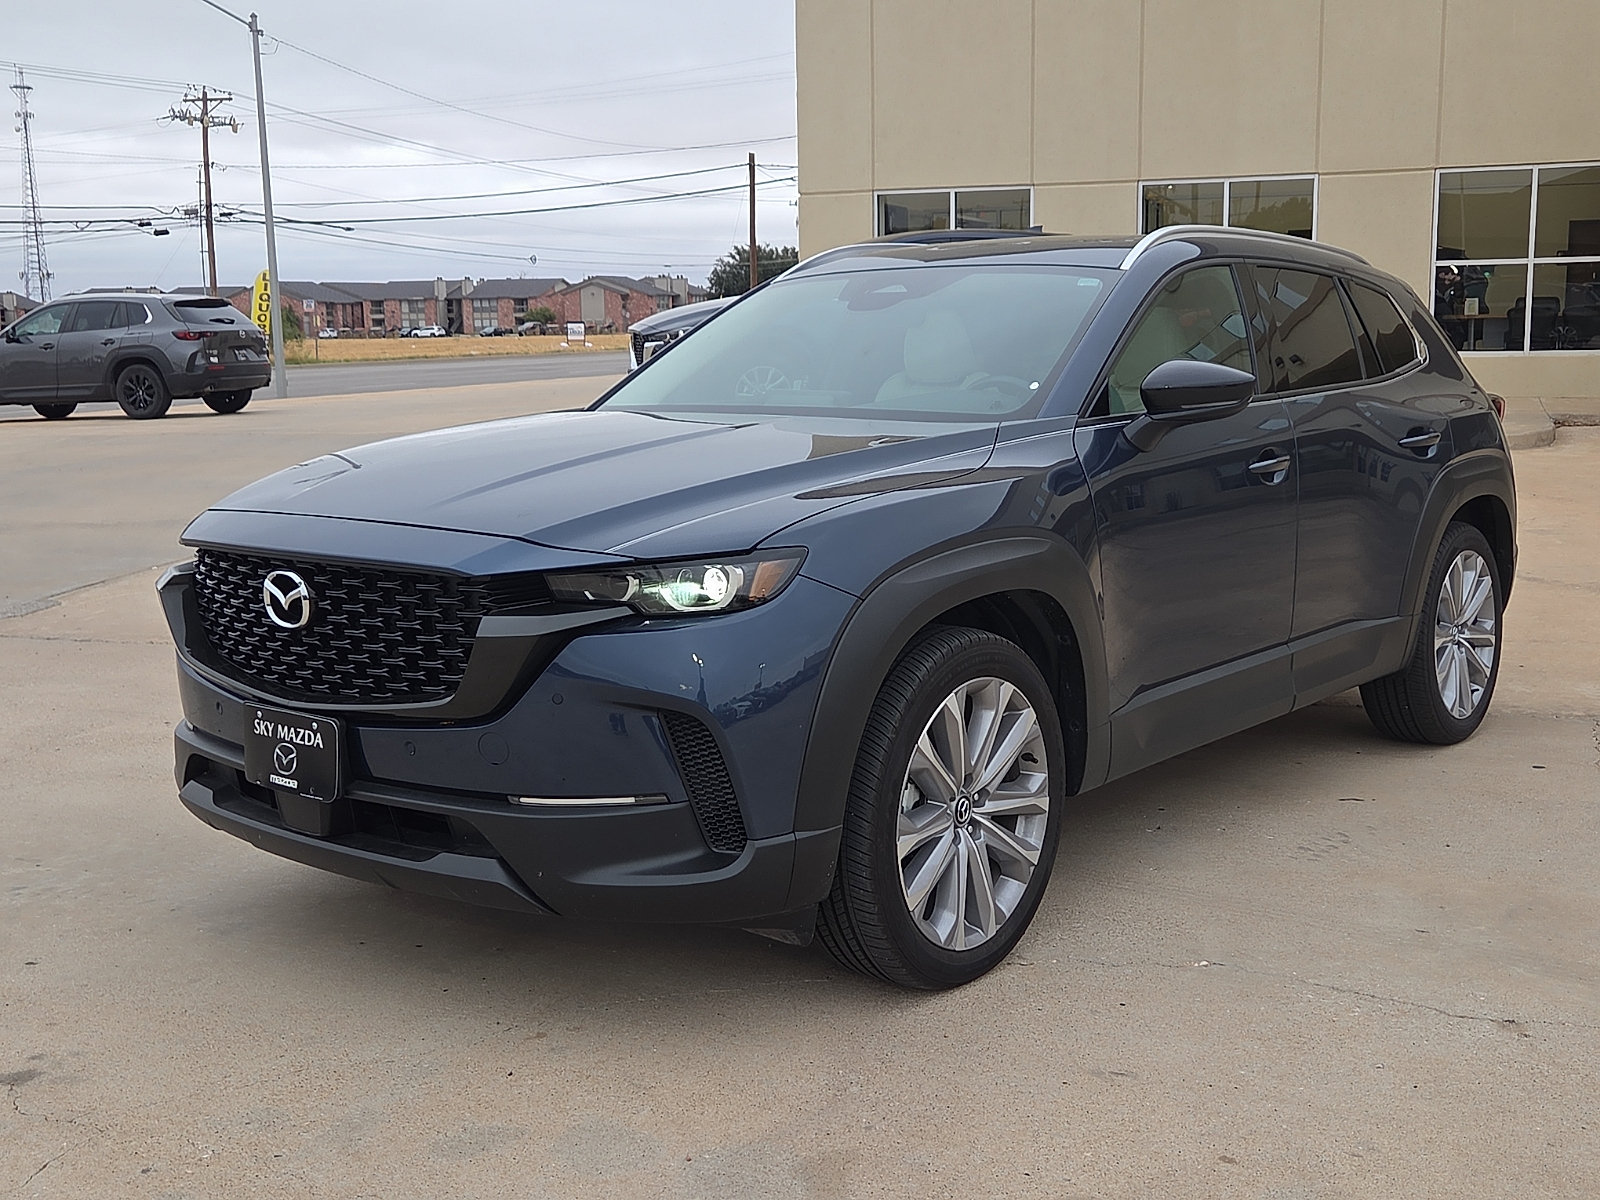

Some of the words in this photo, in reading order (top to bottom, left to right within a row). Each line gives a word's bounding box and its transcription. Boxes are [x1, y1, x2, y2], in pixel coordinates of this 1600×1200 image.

[257, 272, 271, 333] LIQUOR
[253, 718, 274, 738] SKY
[276, 723, 324, 749] MAZDA
